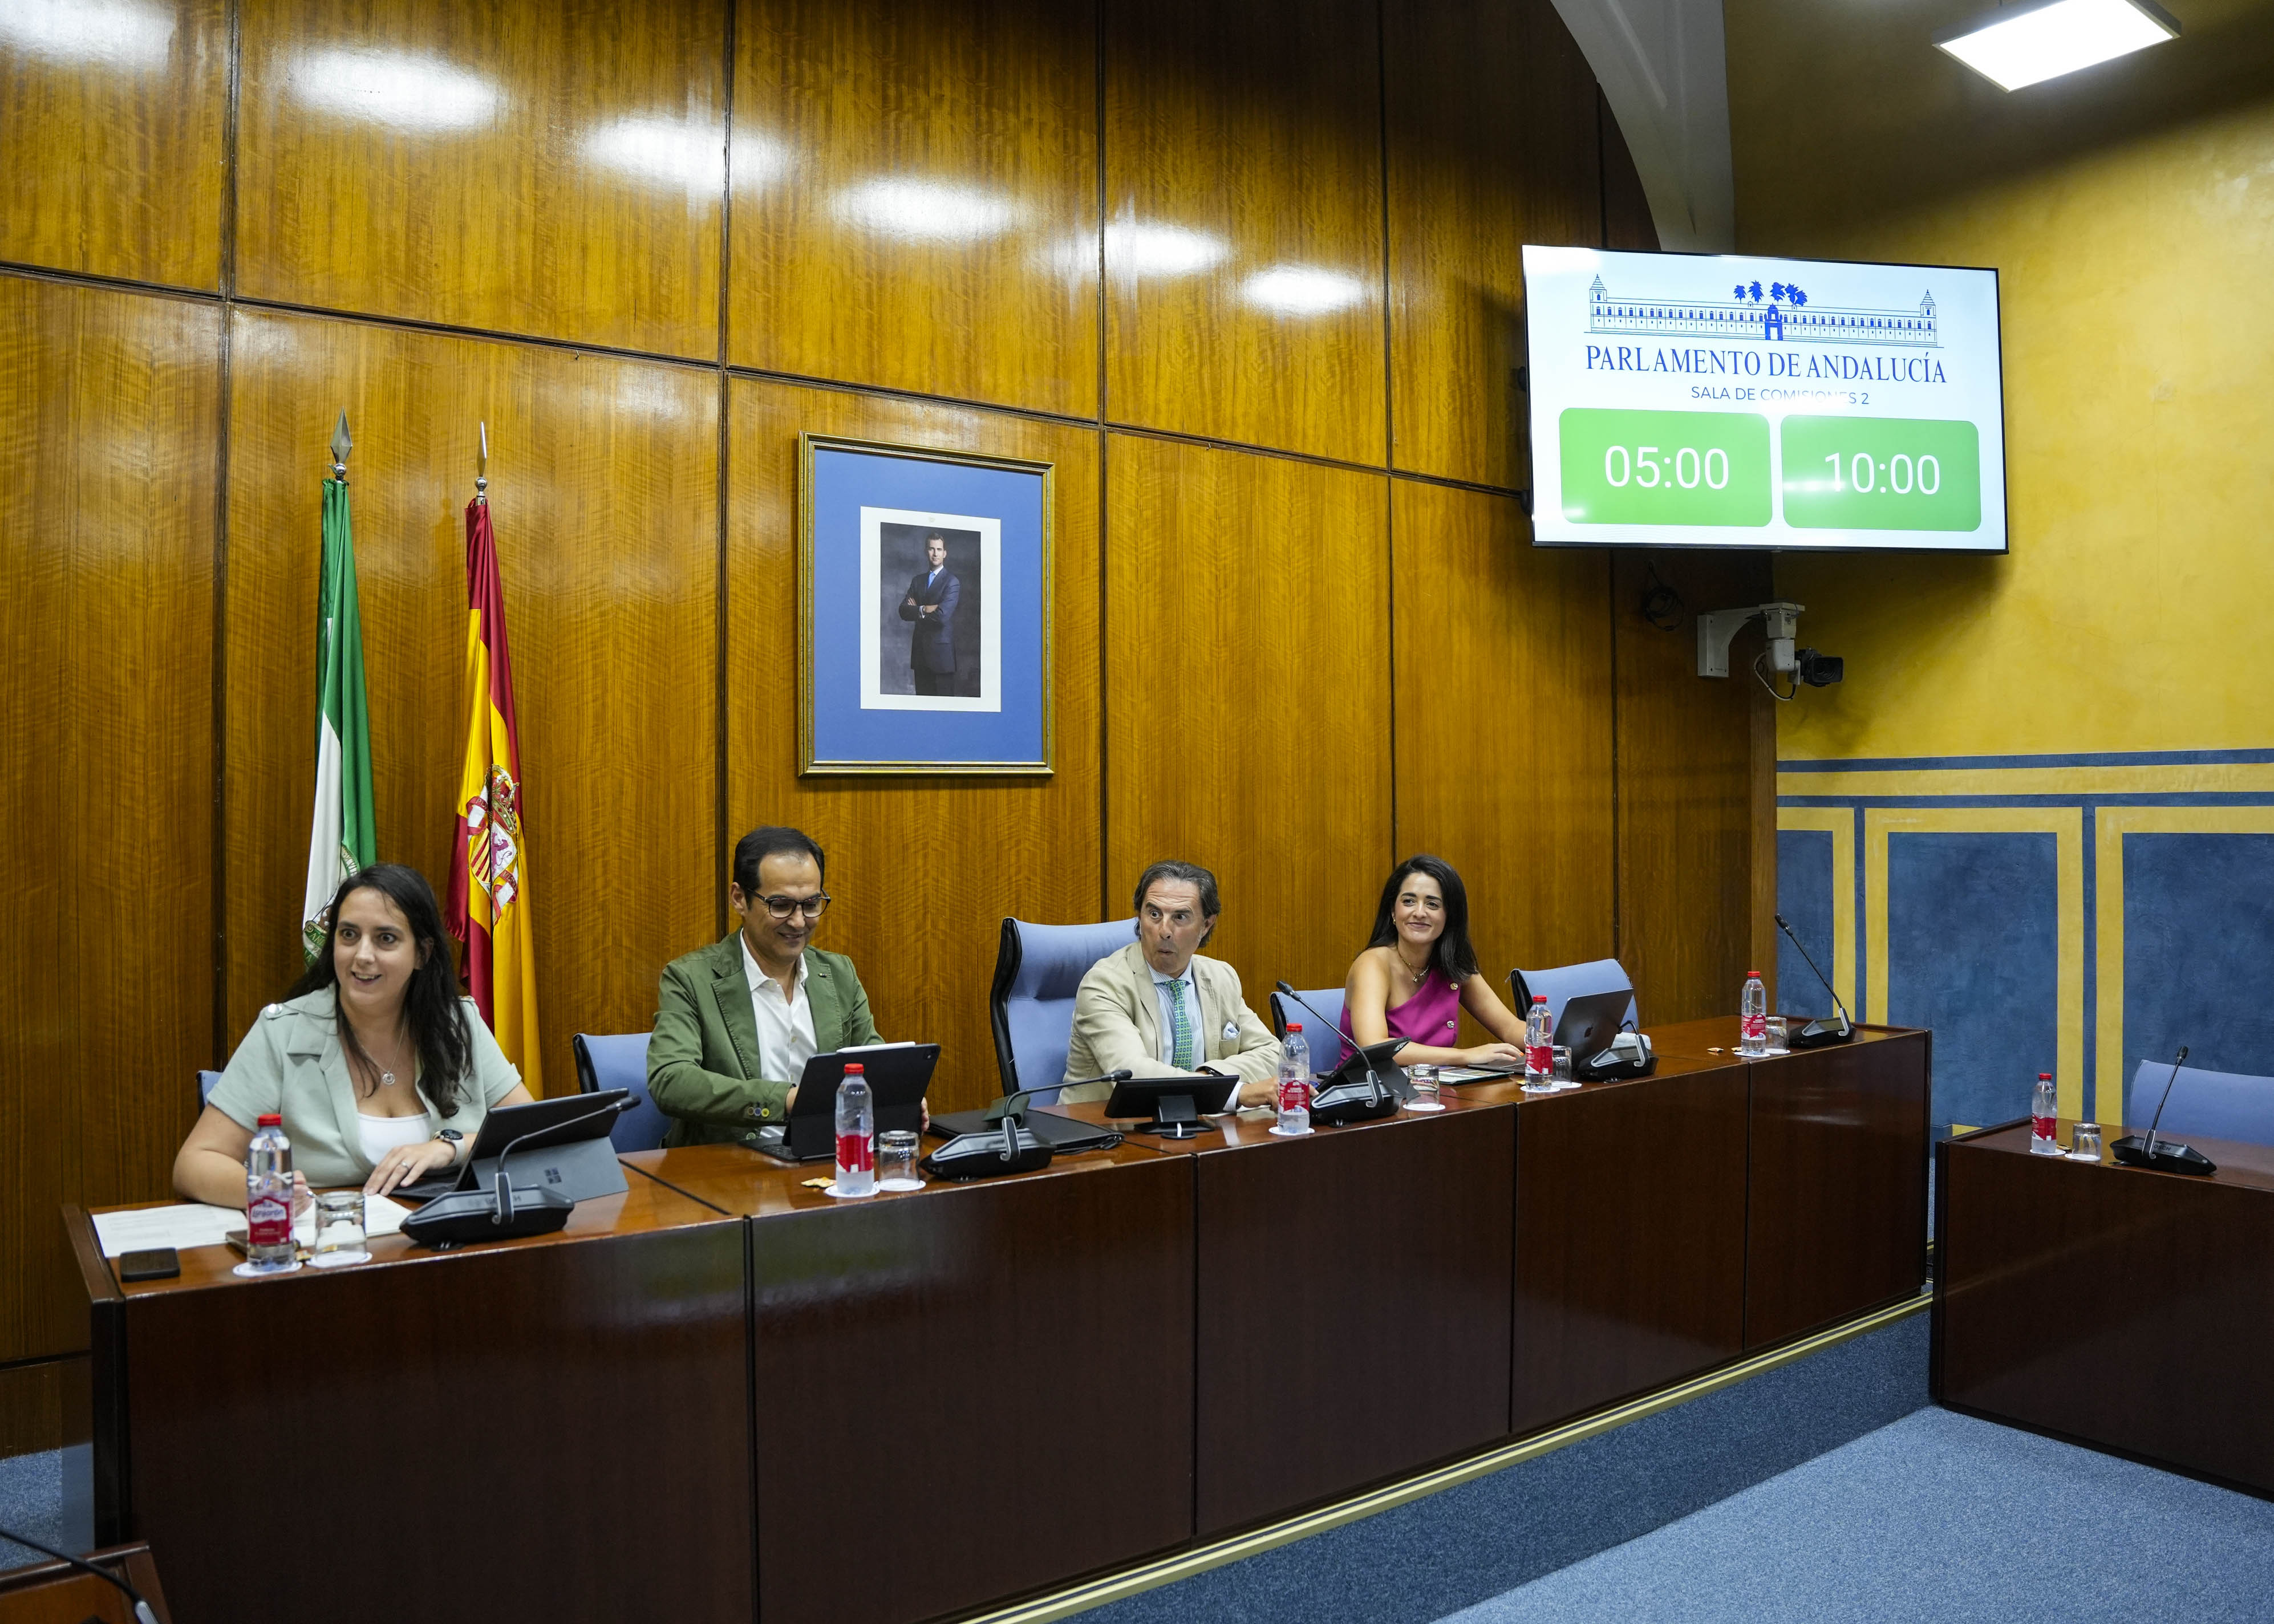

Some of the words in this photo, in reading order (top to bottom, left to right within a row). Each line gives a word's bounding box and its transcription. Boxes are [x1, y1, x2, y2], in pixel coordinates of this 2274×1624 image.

[1585, 345, 1761, 376] PARLAMENTO
[1768, 352, 1802, 377] DE
[1806, 351, 1948, 383] ANDALUCÍA
[1691, 386, 1730, 400] SALA
[1736, 388, 1756, 400] DE
[1861, 392, 1870, 404] 2
[1604, 445, 1729, 489] 05:00
[1825, 452, 1940, 495] 10:00
